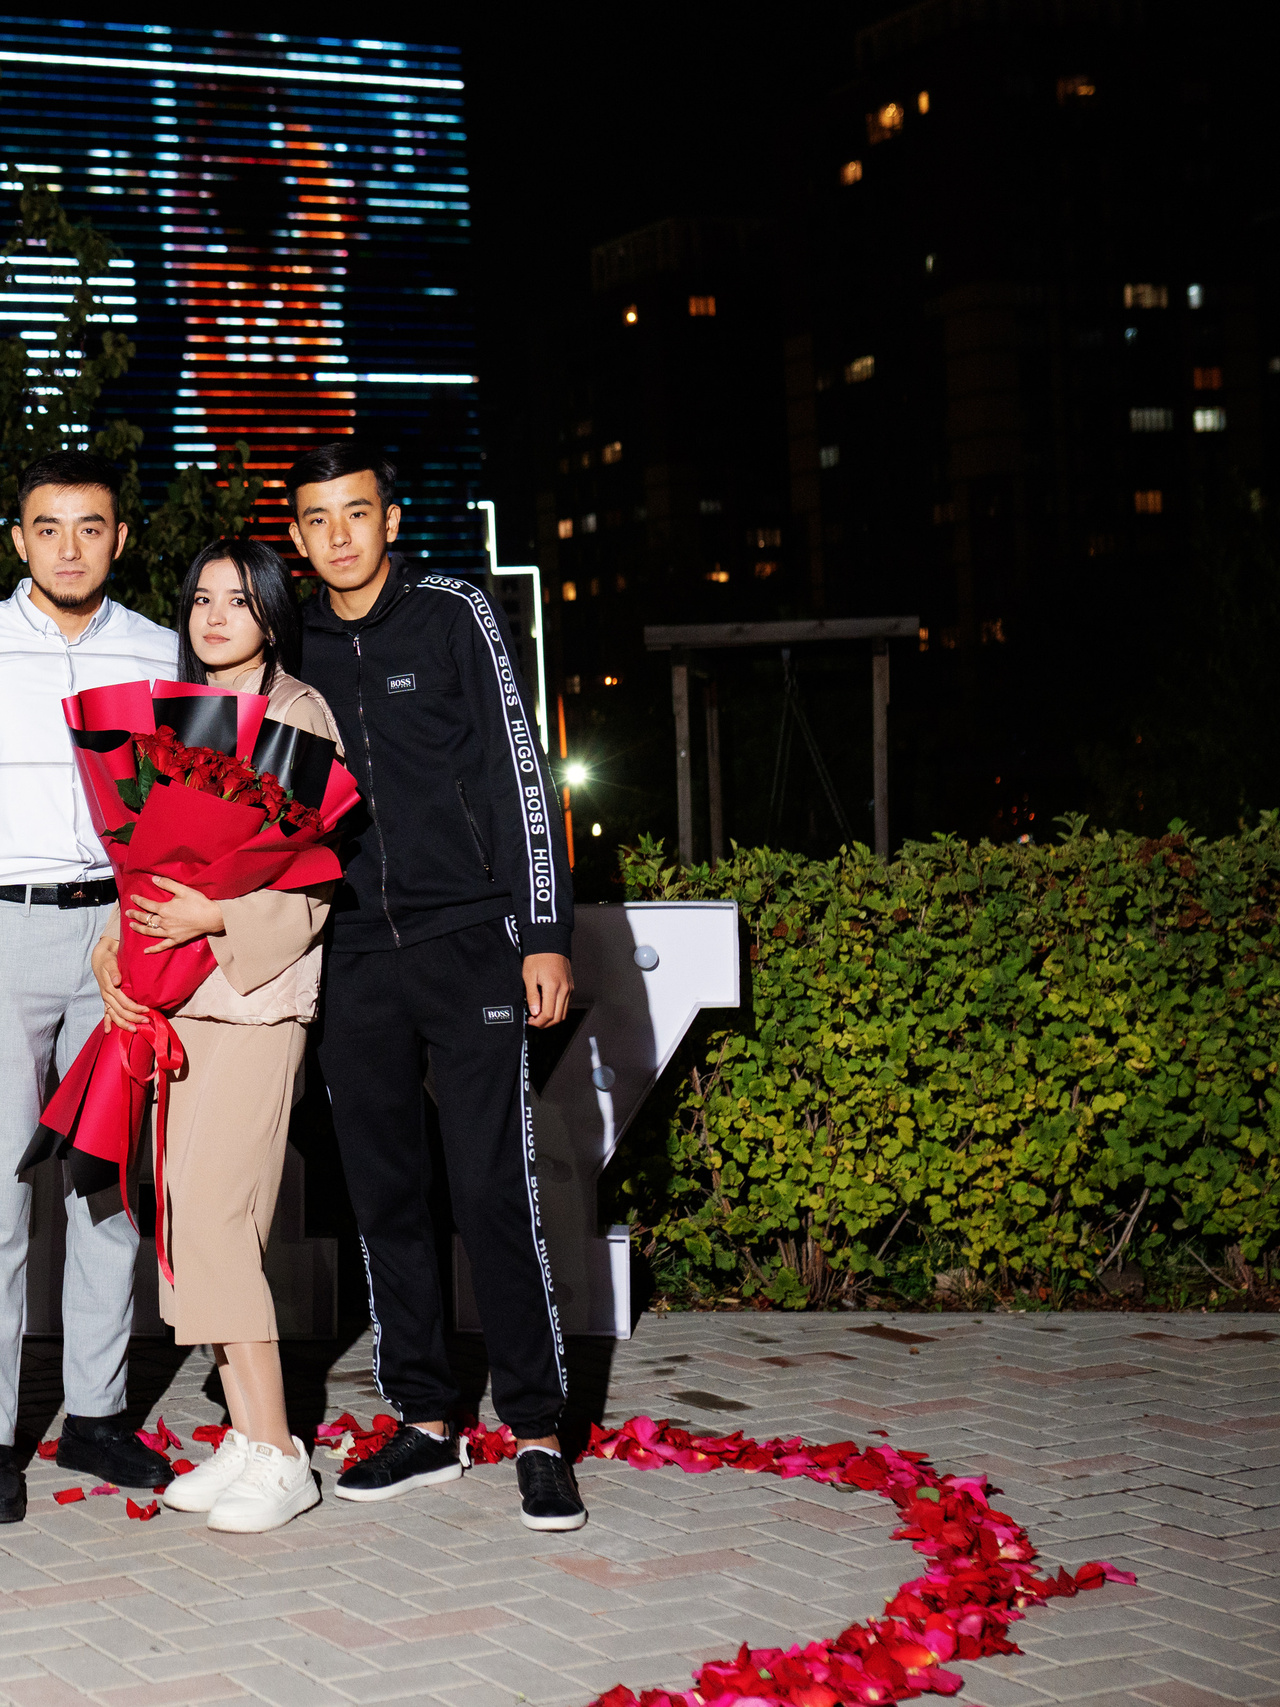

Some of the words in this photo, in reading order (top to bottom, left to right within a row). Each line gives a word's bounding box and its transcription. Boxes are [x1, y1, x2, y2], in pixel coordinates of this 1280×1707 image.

[469, 591, 501, 642] HUGO
[390, 677, 412, 688] BOSS
[497, 655, 519, 707] BOSS
[510, 719, 535, 773] HUGO
[524, 785, 546, 835] BOSS
[532, 848, 552, 902] HUGO
[487, 1009, 511, 1018] BOSS
